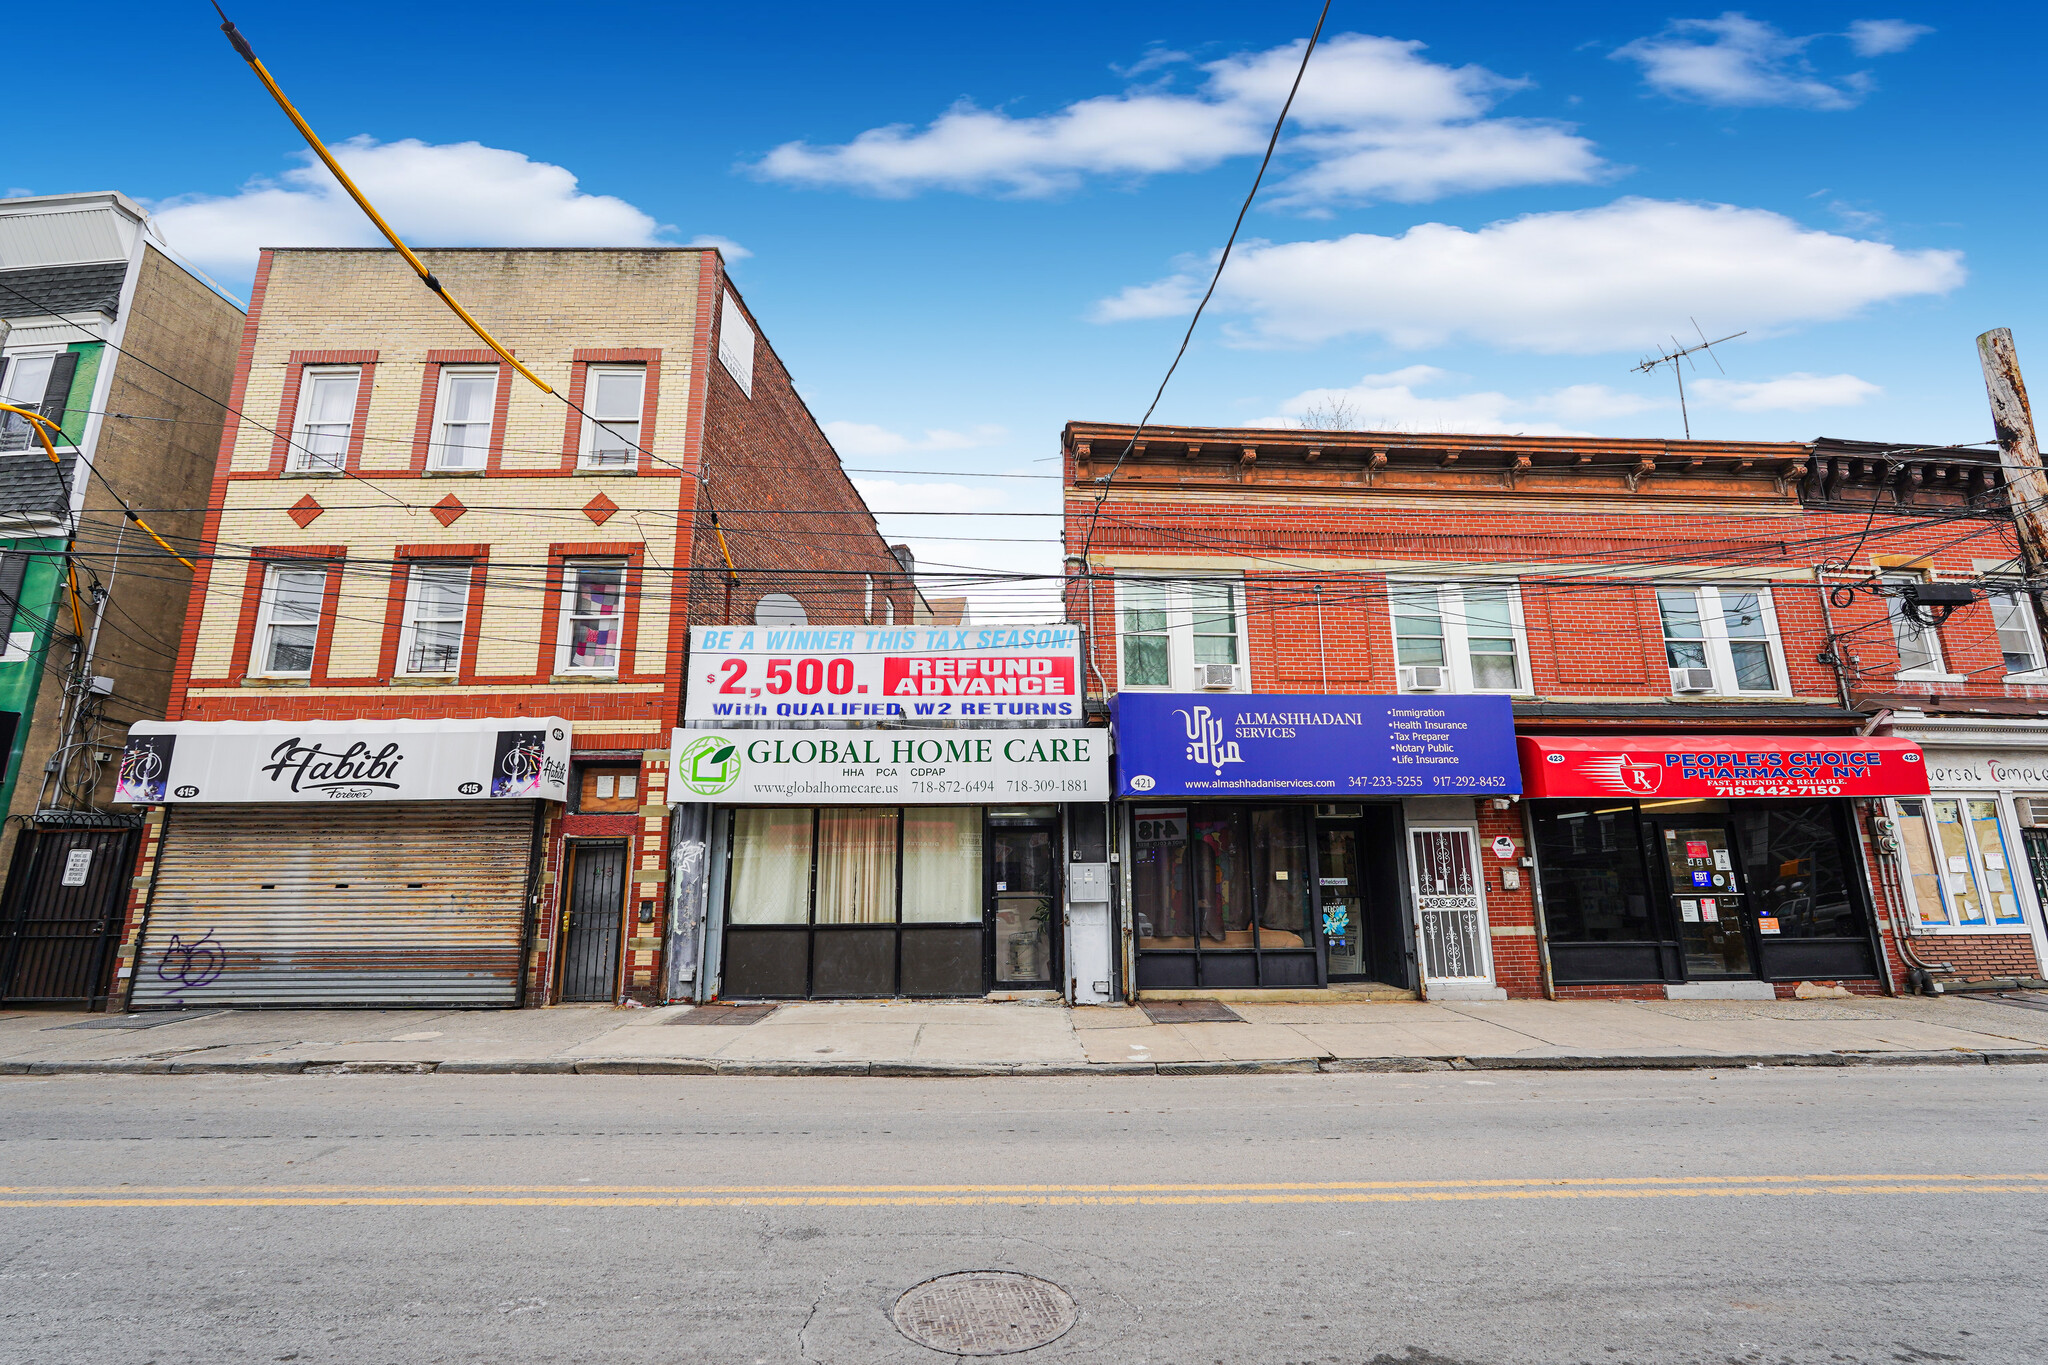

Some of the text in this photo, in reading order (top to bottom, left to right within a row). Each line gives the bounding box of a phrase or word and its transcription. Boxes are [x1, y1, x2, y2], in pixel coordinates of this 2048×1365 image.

[702, 629, 1075, 650] BE A WINNER THIS TAX SEASON!
[909, 658, 1053, 676] REFUND
[894, 676, 1065, 694] ADVANCE
[713, 702, 1072, 717] With QUALIFIED W2 RETURNS
[1392, 708, 1445, 718] Immigration
[1235, 712, 1363, 726] ALMASHHADANI
[1393, 721, 1467, 730] Health Insurance
[1235, 727, 1296, 738] SERVICES
[1394, 732, 1450, 742] Tax Preparer
[747, 738, 1090, 764] GLOBAL HOME CARE
[1396, 744, 1454, 754] Notary Public
[262, 737, 403, 792] Habibi
[1397, 755, 1459, 764] Life Insurance
[1665, 751, 1881, 767] PEOPLE'S CHOICE
[543, 756, 566, 783] Habibi
[843, 768, 946, 777] HHA PCA CDPAP
[1683, 766, 1820, 780] PHARMACY
[1833, 766, 1866, 778] NY
[1987, 759, 2048, 785] Temple
[1134, 778, 1151, 788] 421
[1185, 776, 1506, 788] www.almashhadaniservices.com 347-233-5255 917-292-8452
[177, 787, 196, 797] 415
[321, 787, 372, 798] Forever
[461, 784, 479, 793] 415
[754, 779, 1087, 797] www.globalhomecare.us 718-872-6494 718-309-1881
[1715, 786, 1841, 796] 718-442-7150
[1693, 872, 1708, 881] EBT
[1322, 905, 1347, 913] WELCOME
